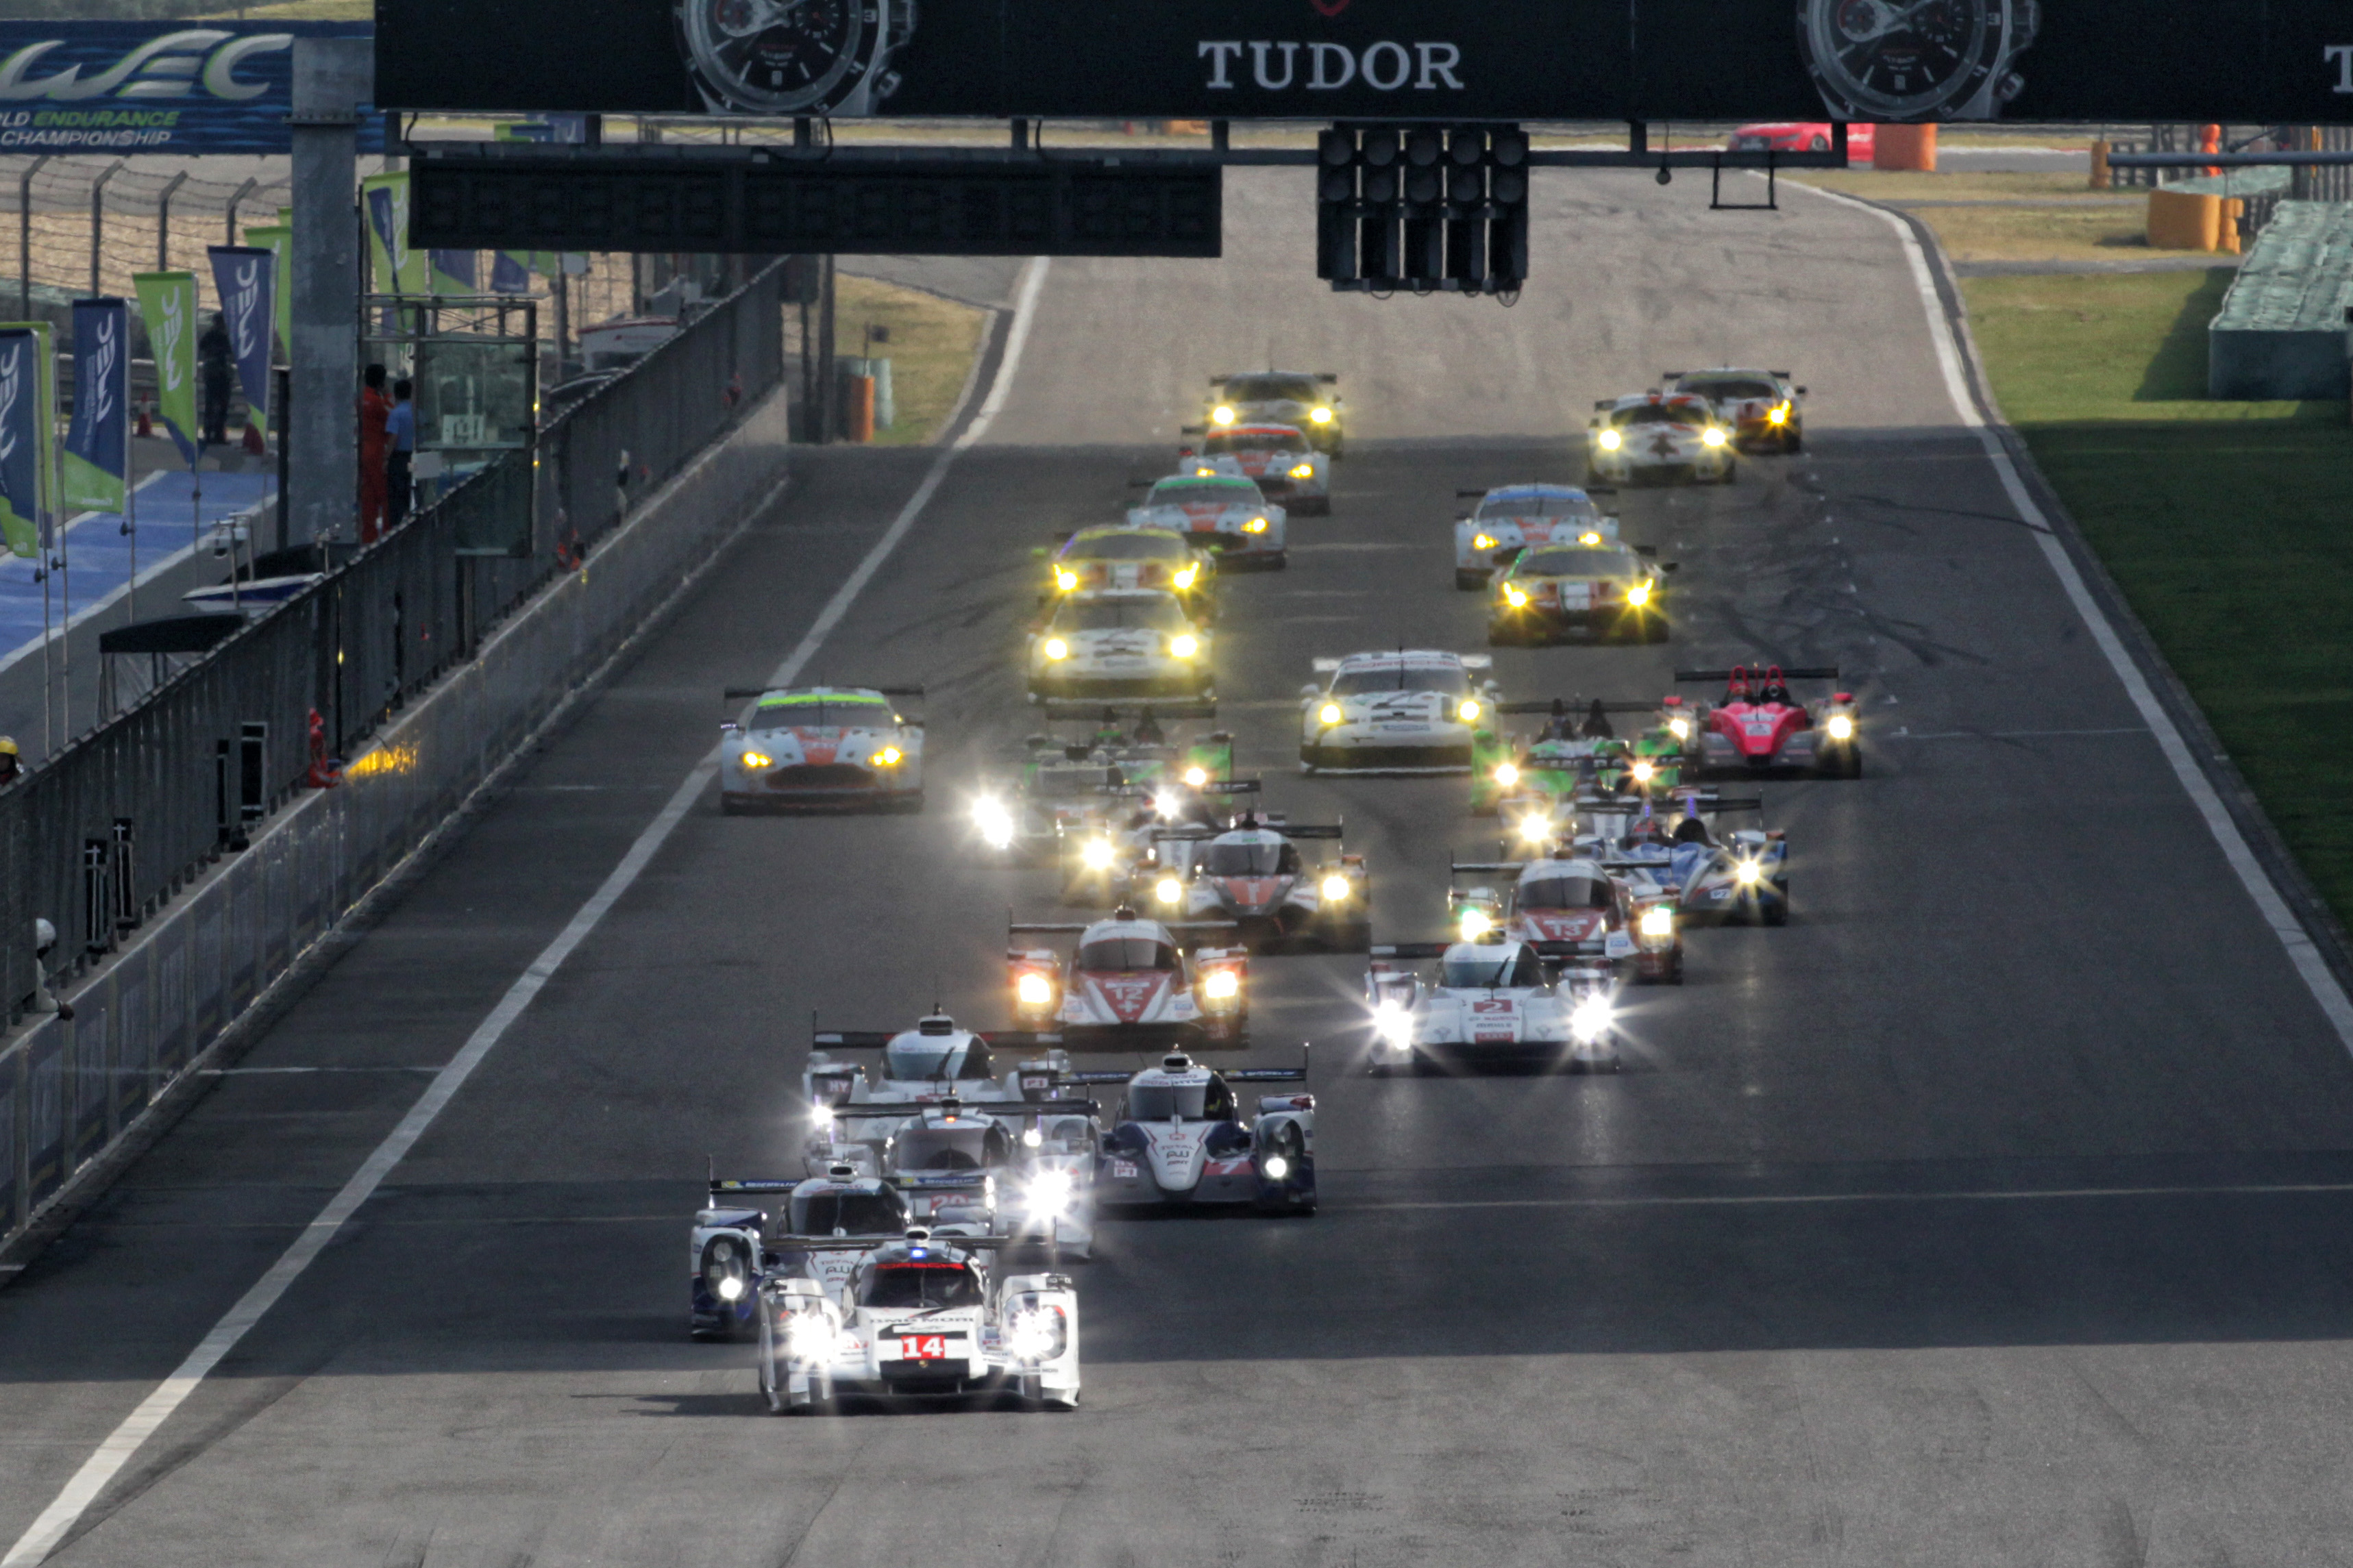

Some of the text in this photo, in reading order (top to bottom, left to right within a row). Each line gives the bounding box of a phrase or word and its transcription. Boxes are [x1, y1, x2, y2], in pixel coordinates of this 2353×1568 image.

[1198, 40, 1465, 90] TUDOR
[34, 111, 180, 127] ENDURANCE
[1, 129, 171, 146] CHAMPIONSHIP
[1550, 924, 1583, 937] 13
[1111, 987, 1144, 1000] 12
[1481, 1000, 1505, 1014] 2
[903, 1336, 944, 1358] 14
